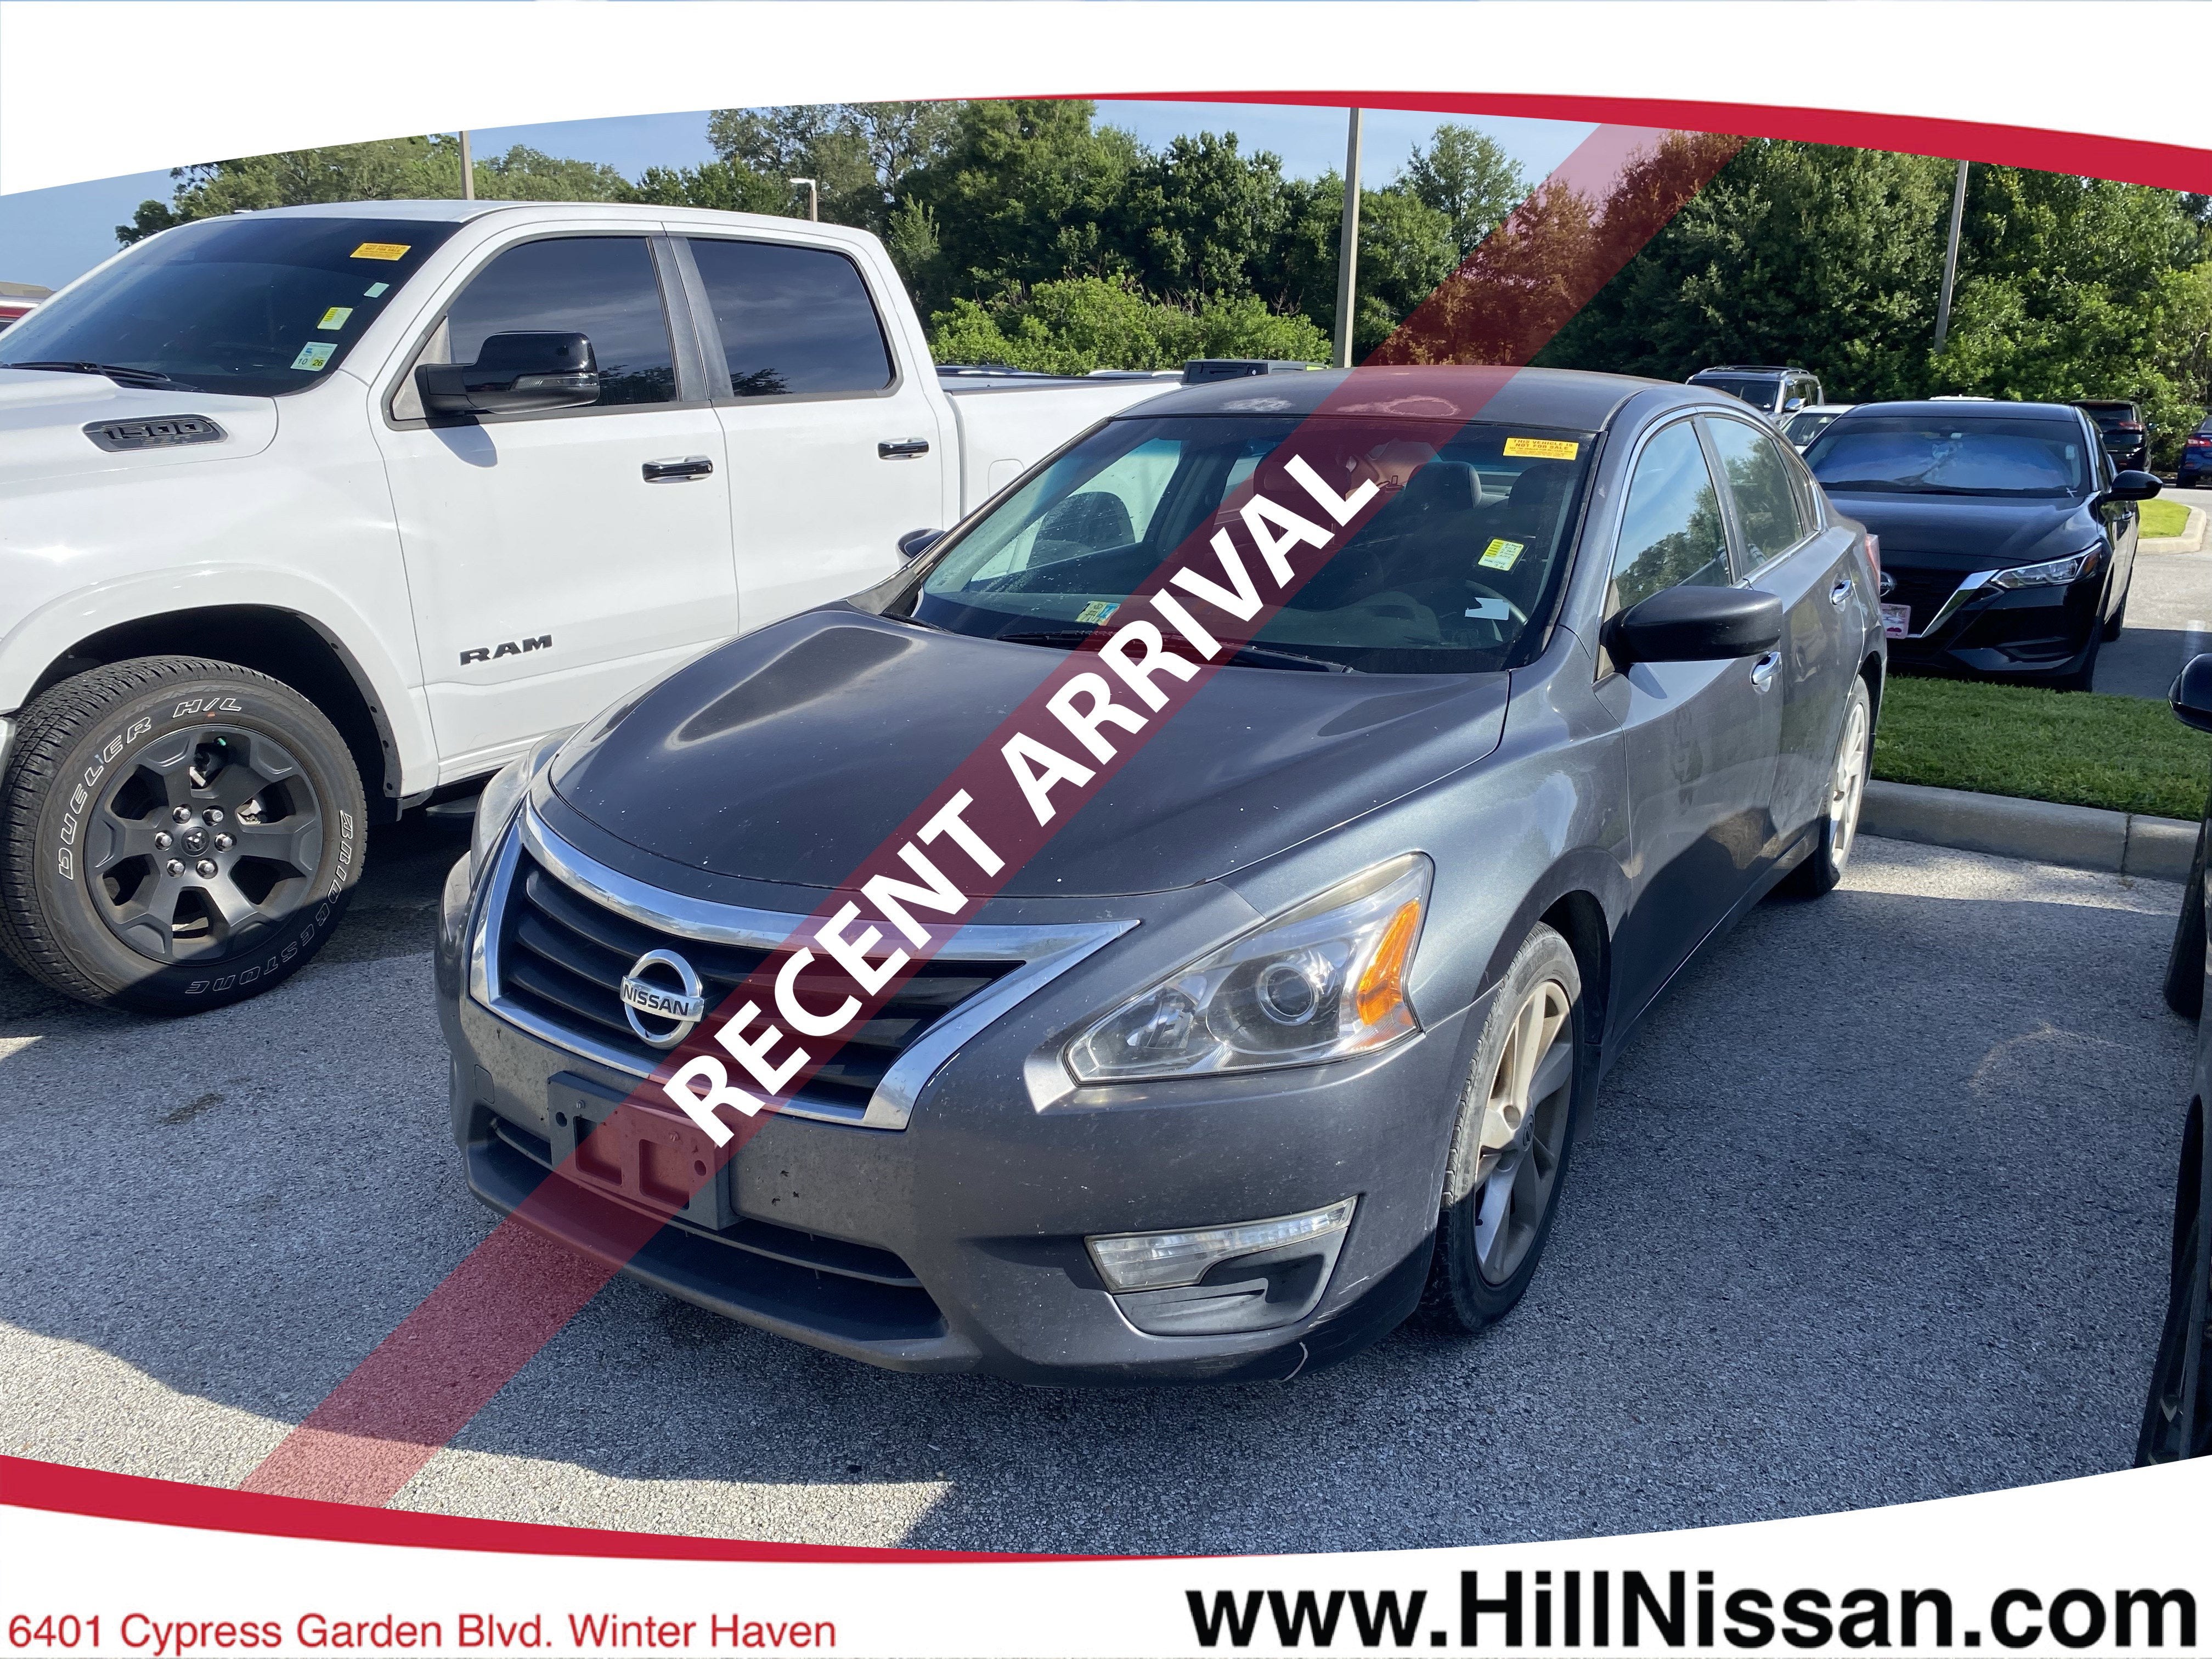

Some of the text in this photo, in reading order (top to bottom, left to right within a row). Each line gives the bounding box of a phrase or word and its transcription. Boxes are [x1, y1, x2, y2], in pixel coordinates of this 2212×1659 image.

[106, 421, 204, 440] 1500
[460, 634, 553, 666] RAM
[58, 697, 242, 880] DUELER H/L
[184, 809, 353, 994] BRIDGESTONE
[623, 984, 689, 1016] NISSAN
